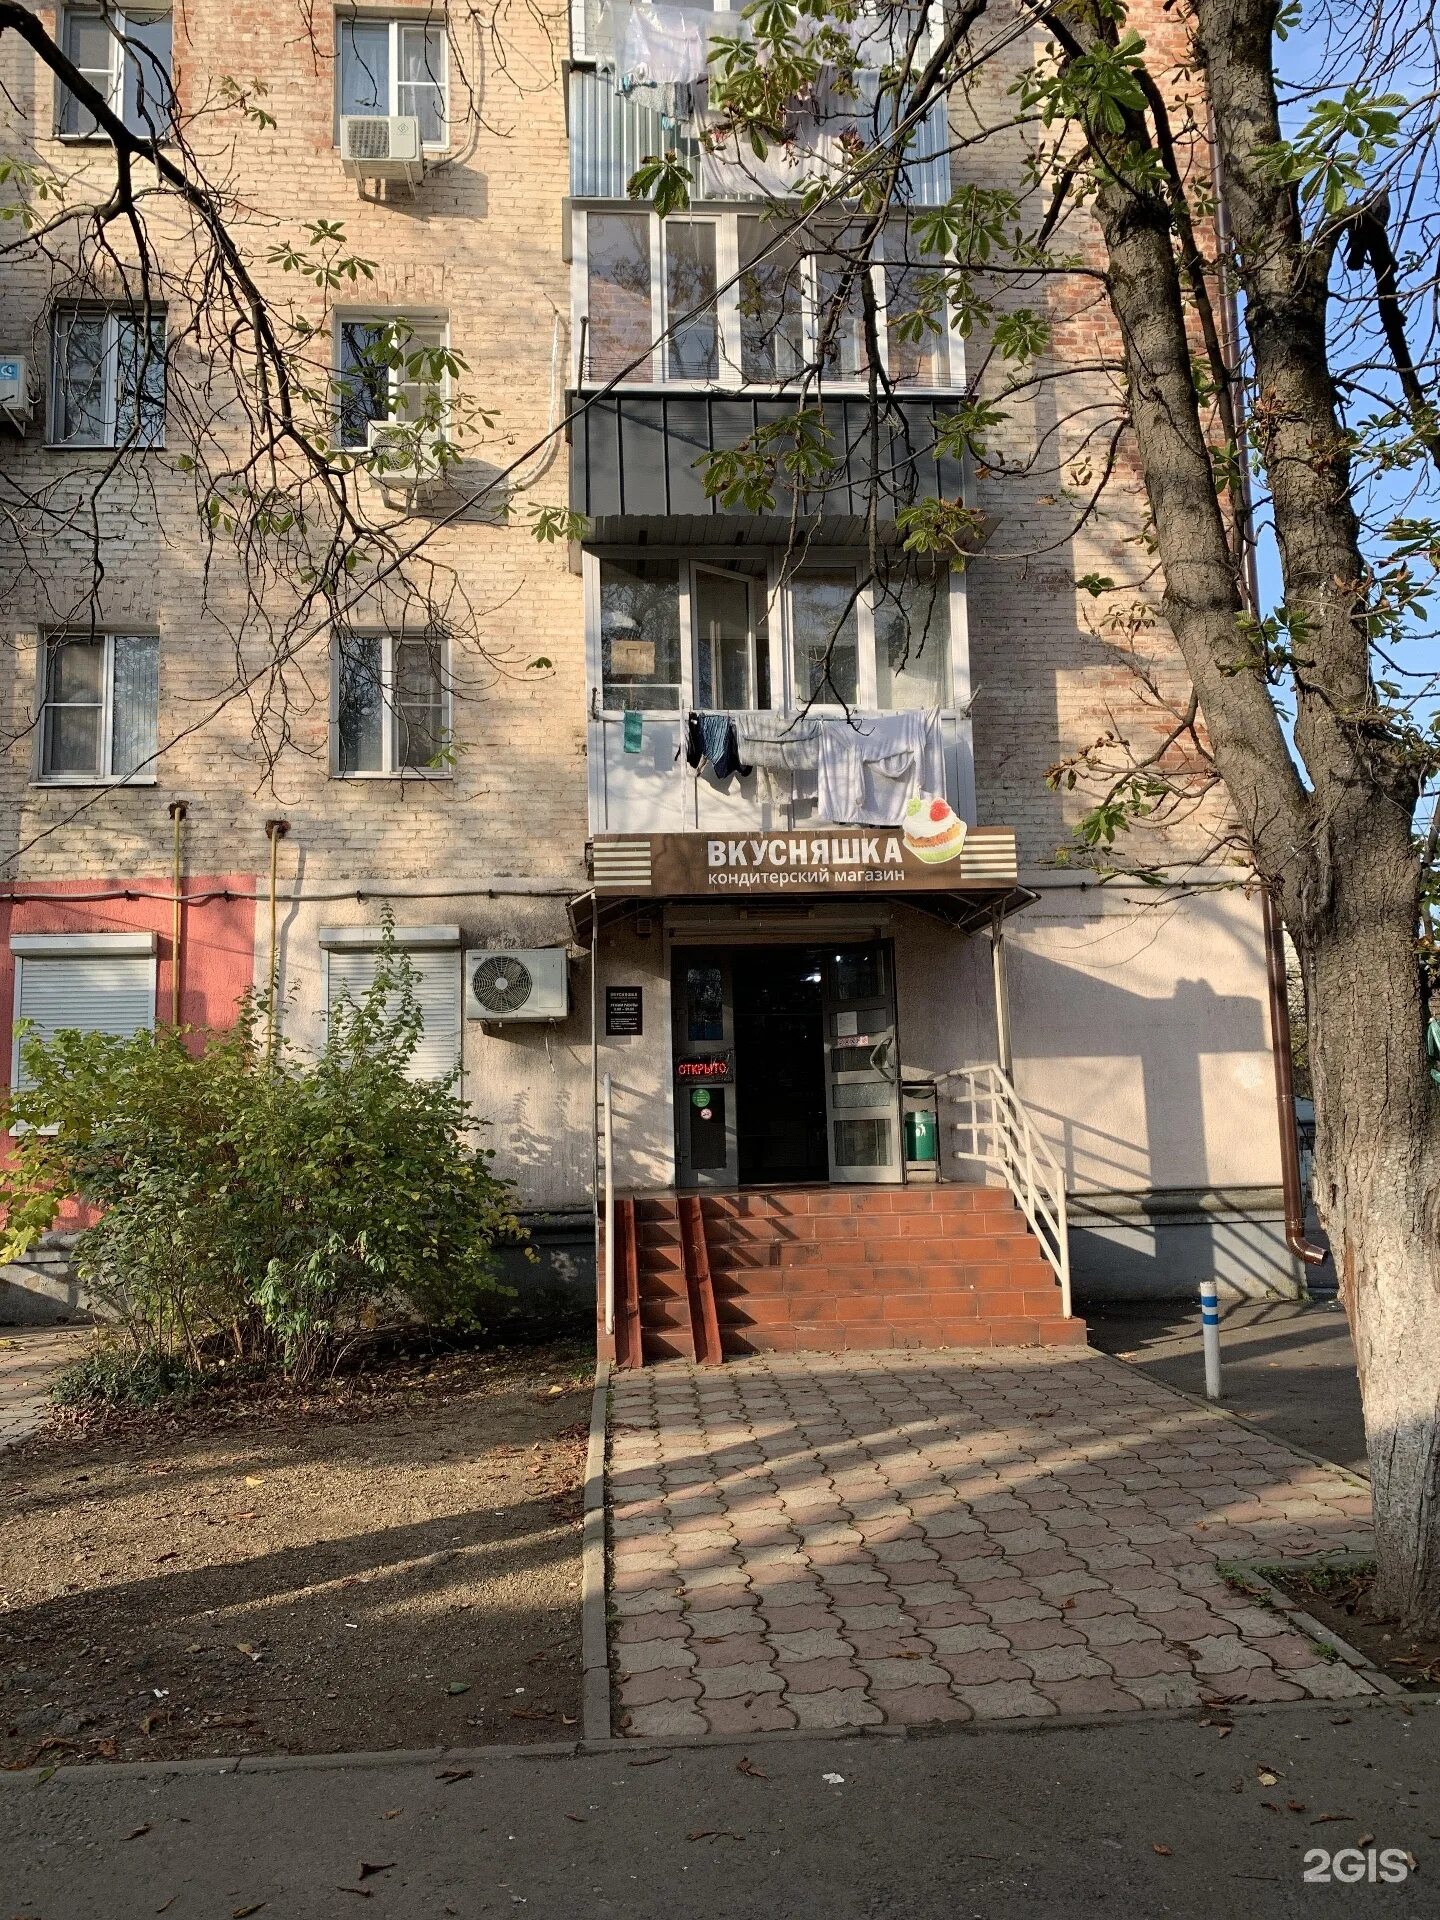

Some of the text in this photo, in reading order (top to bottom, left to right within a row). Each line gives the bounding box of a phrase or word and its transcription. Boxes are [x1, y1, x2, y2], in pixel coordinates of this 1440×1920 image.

[707, 837, 904, 867] ВКУСНЯШКА
[708, 868, 905, 887] кондитерский магазин
[679, 1063, 727, 1075] ОТКРЫТО
